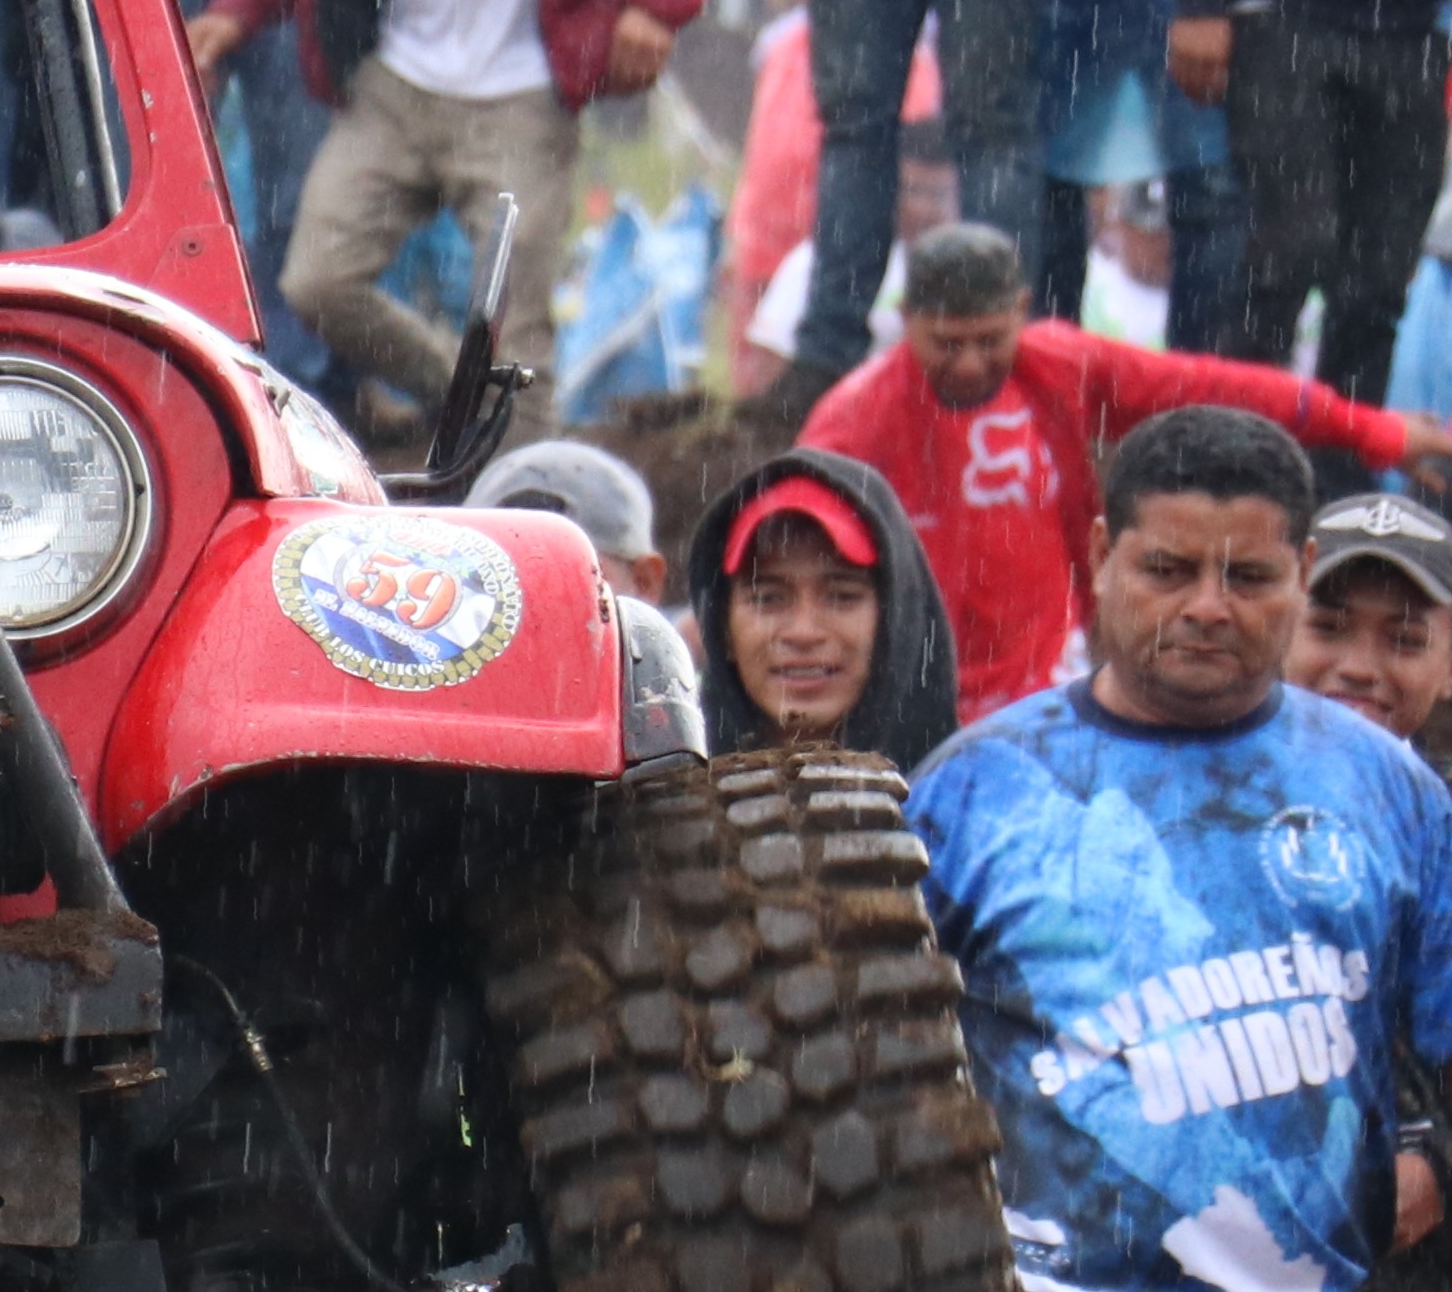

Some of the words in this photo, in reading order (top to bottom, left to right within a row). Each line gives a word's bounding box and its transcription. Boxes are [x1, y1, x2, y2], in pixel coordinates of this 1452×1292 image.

[346, 548, 456, 629] 59
[328, 637, 366, 664] LOS
[368, 658, 445, 677] CUICOS
[1123, 995, 1357, 1126] UNIDOS
